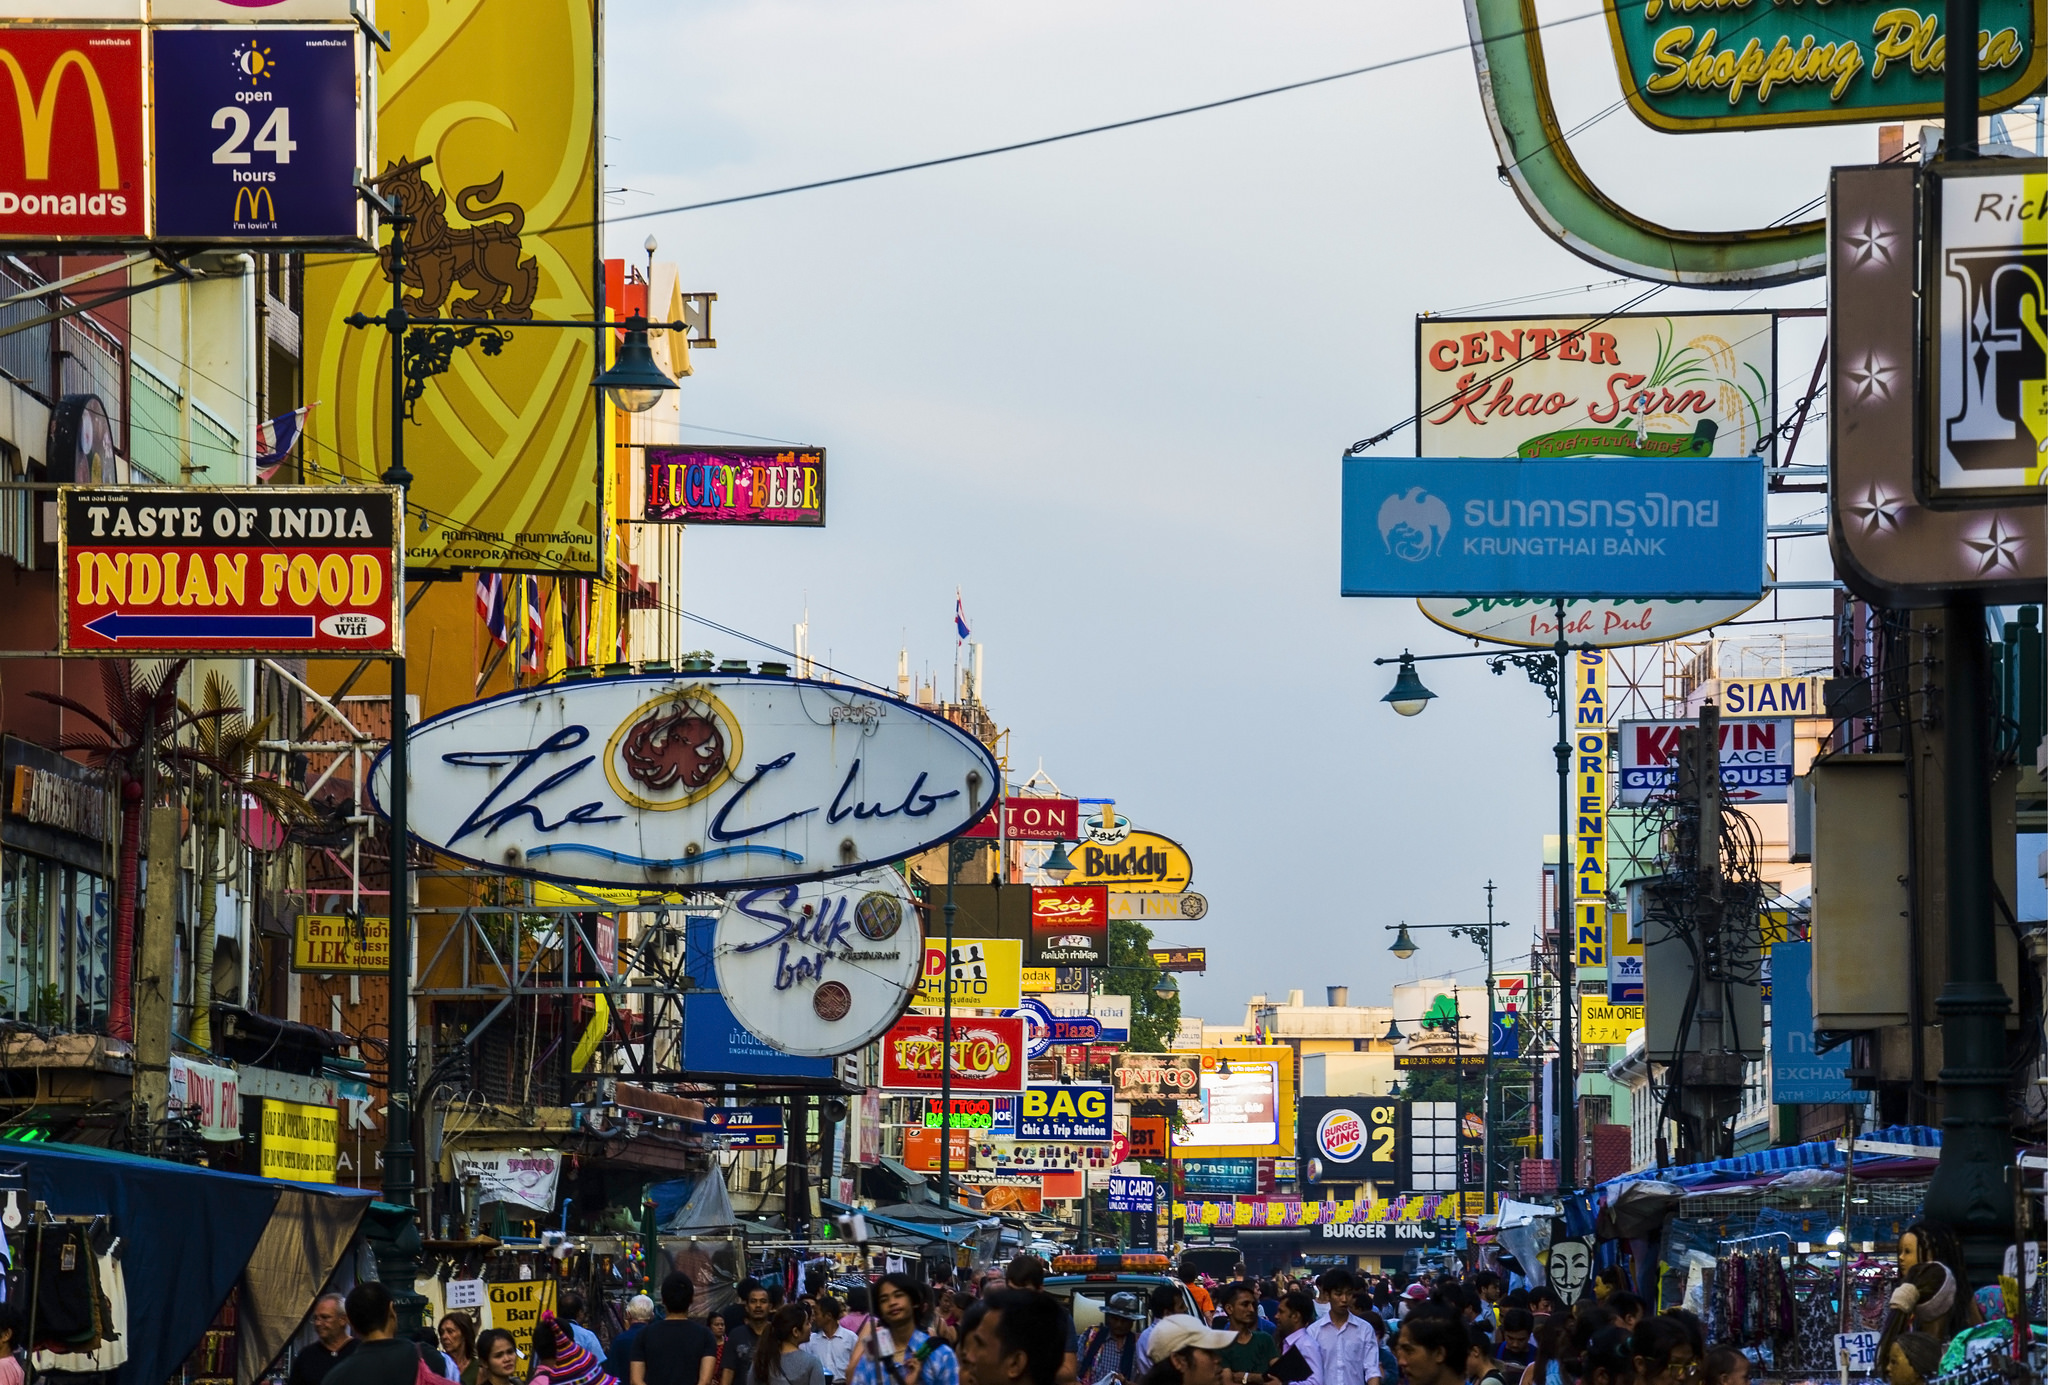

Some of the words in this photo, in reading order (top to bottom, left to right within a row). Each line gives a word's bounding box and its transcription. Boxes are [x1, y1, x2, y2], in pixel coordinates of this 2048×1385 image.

[1647, 26, 1864, 104] Shopping
[1872, 9, 2023, 79] Plaa
[235, 89, 272, 102] open
[211, 106, 297, 164] 24
[233, 169, 276, 182] hours
[233, 222, 245, 230] i'm
[271, 222, 278, 230] it
[1429, 328, 1621, 371] CENTER
[1427, 372, 1580, 425] Khao
[1587, 372, 1716, 423] Sarn
[650, 464, 740, 508] LUCKY
[750, 465, 820, 509] BEER
[88, 506, 202, 537] TASTE
[213, 508, 258, 537] OF
[269, 508, 374, 538] INDIA
[1464, 493, 1719, 538] ธนาคารกรุงไทย
[443, 548, 540, 561] CORPORATION
[1465, 538, 1598, 556] KRUNGTHAI
[1603, 538, 1666, 556] BANK
[77, 552, 249, 606] INDIAN
[260, 553, 383, 606] FOOD
[334, 623, 368, 637] Wifi
[339, 616, 368, 624] FREE
[1530, 609, 1593, 636] Irish
[1603, 607, 1653, 635] Pub
[1579, 649, 1603, 724] SIAM
[1726, 682, 1806, 713] SIAM
[442, 724, 628, 847] The
[708, 752, 961, 842] Club
[1579, 735, 1603, 895] ORIENTAL
[1085, 846, 1167, 881] Buddy
[1038, 897, 1095, 916] Roof
[1140, 898, 1178, 915] INN
[734, 884, 853, 953] Silk
[1579, 906, 1603, 965] INN
[307, 941, 349, 965] LEK
[353, 955, 389, 966] HOUSE
[773, 942, 836, 990] bar
[1022, 970, 1051, 981] odak
[1621, 967, 1641, 975] IATA
[1587, 1007, 1614, 1020] SIAM
[1054, 1023, 1096, 1038] Plaza
[893, 1040, 1012, 1072] TATTOO
[1113, 1067, 1198, 1090] TATTOO
[1022, 1090, 1106, 1118] BAG
[728, 1115, 753, 1124] ATM
[1324, 1121, 1359, 1138] BURGER
[1022, 1123, 1041, 1135] Chic
[1043, 1124, 1050, 1135] &
[1053, 1124, 1071, 1138] Trip
[1073, 1124, 1106, 1136] Station
[1325, 1129, 1361, 1150] KING
[1109, 1179, 1126, 1196] SIM
[1128, 1180, 1154, 1197] CARD
[1108, 1202, 1129, 1211] UNLOCK
[1136, 1202, 1153, 1212] PHONE
[1322, 1223, 1387, 1239] BURGER
[1394, 1223, 1435, 1239] KING
[489, 1286, 534, 1304] Golf
[506, 1308, 537, 1322] Bar
